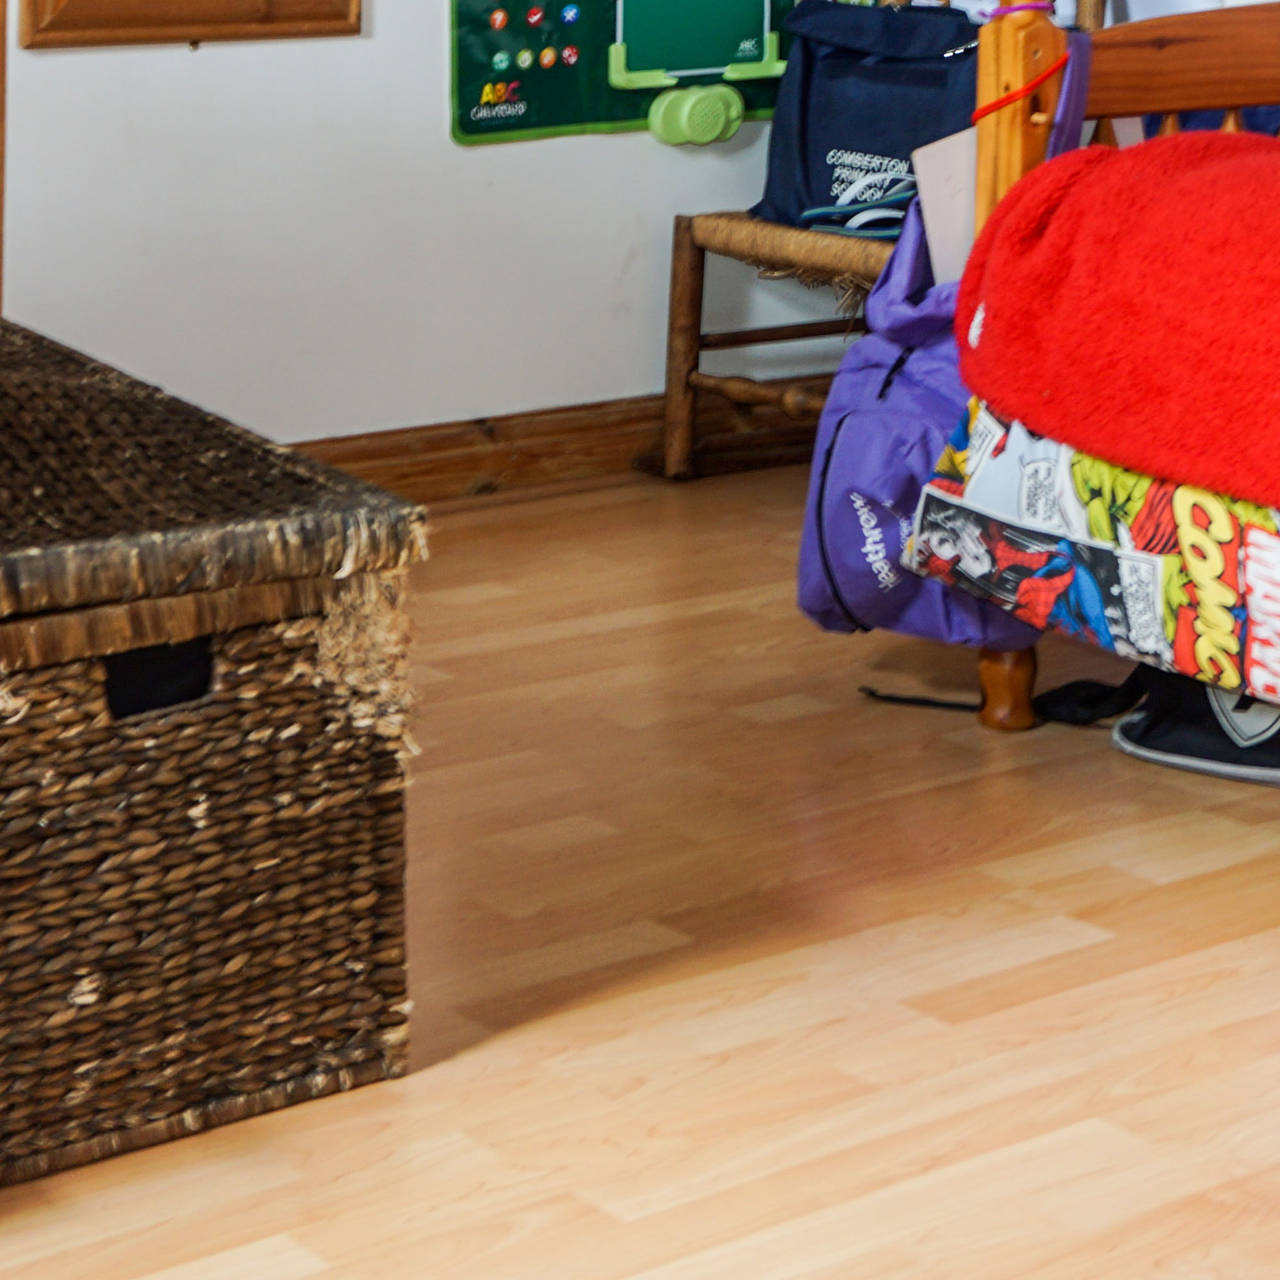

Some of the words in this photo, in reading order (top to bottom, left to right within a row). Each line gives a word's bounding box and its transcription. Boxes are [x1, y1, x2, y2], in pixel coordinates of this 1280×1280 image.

[480, 81, 521, 105] ABC
[826, 149, 911, 173] COMBERTON
[849, 491, 903, 592] Heathrow
